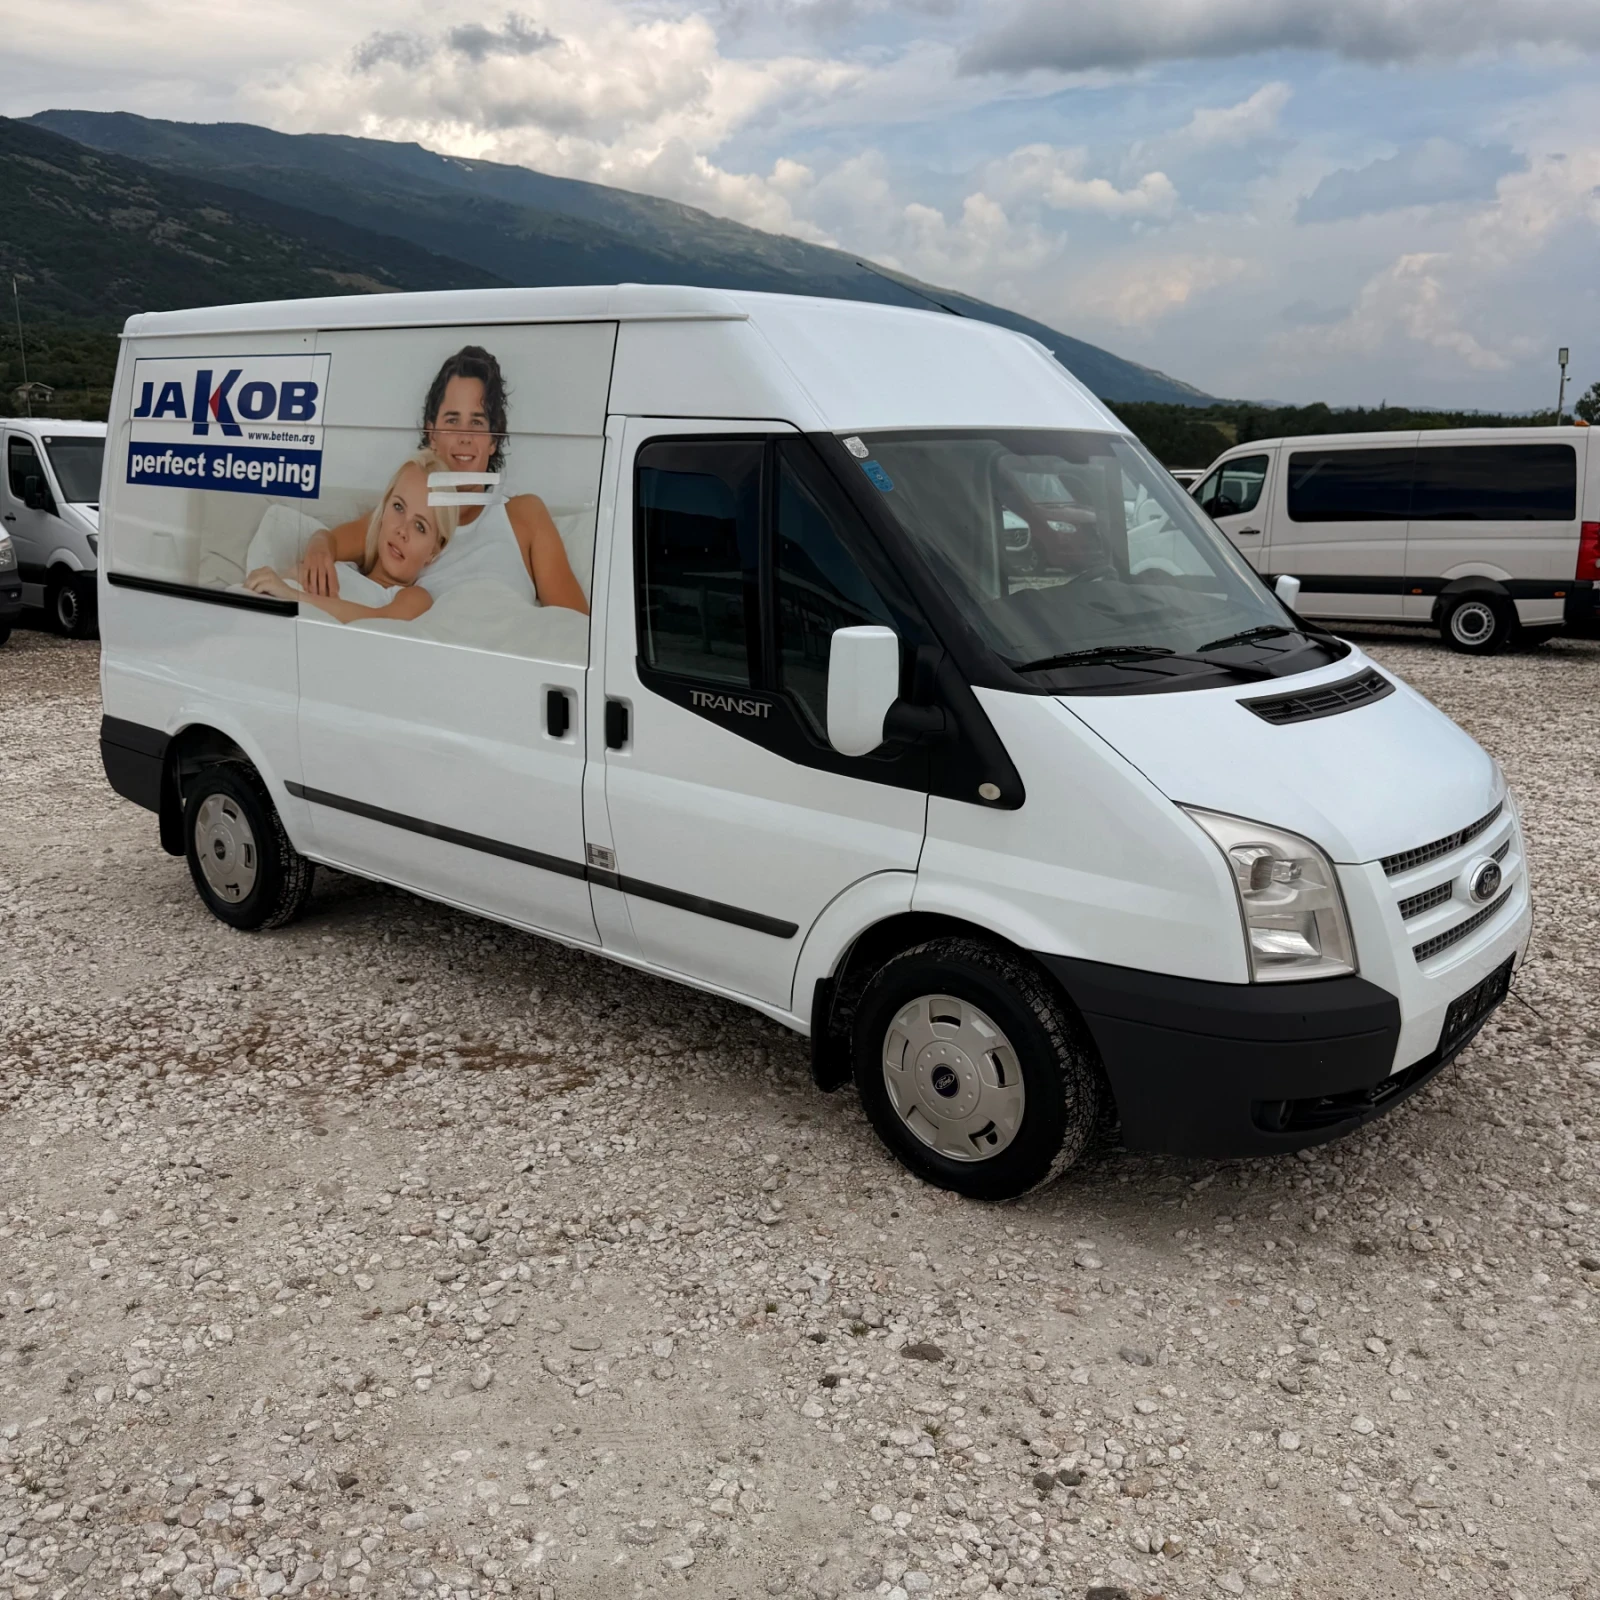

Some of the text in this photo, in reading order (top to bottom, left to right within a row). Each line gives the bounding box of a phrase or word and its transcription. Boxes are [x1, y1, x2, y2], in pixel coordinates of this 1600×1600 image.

[133, 369, 319, 437] JAKOB
[247, 430, 316, 445] www.betten.org
[131, 450, 316, 491] perfect sleeping
[690, 690, 772, 718] TRANSIT
